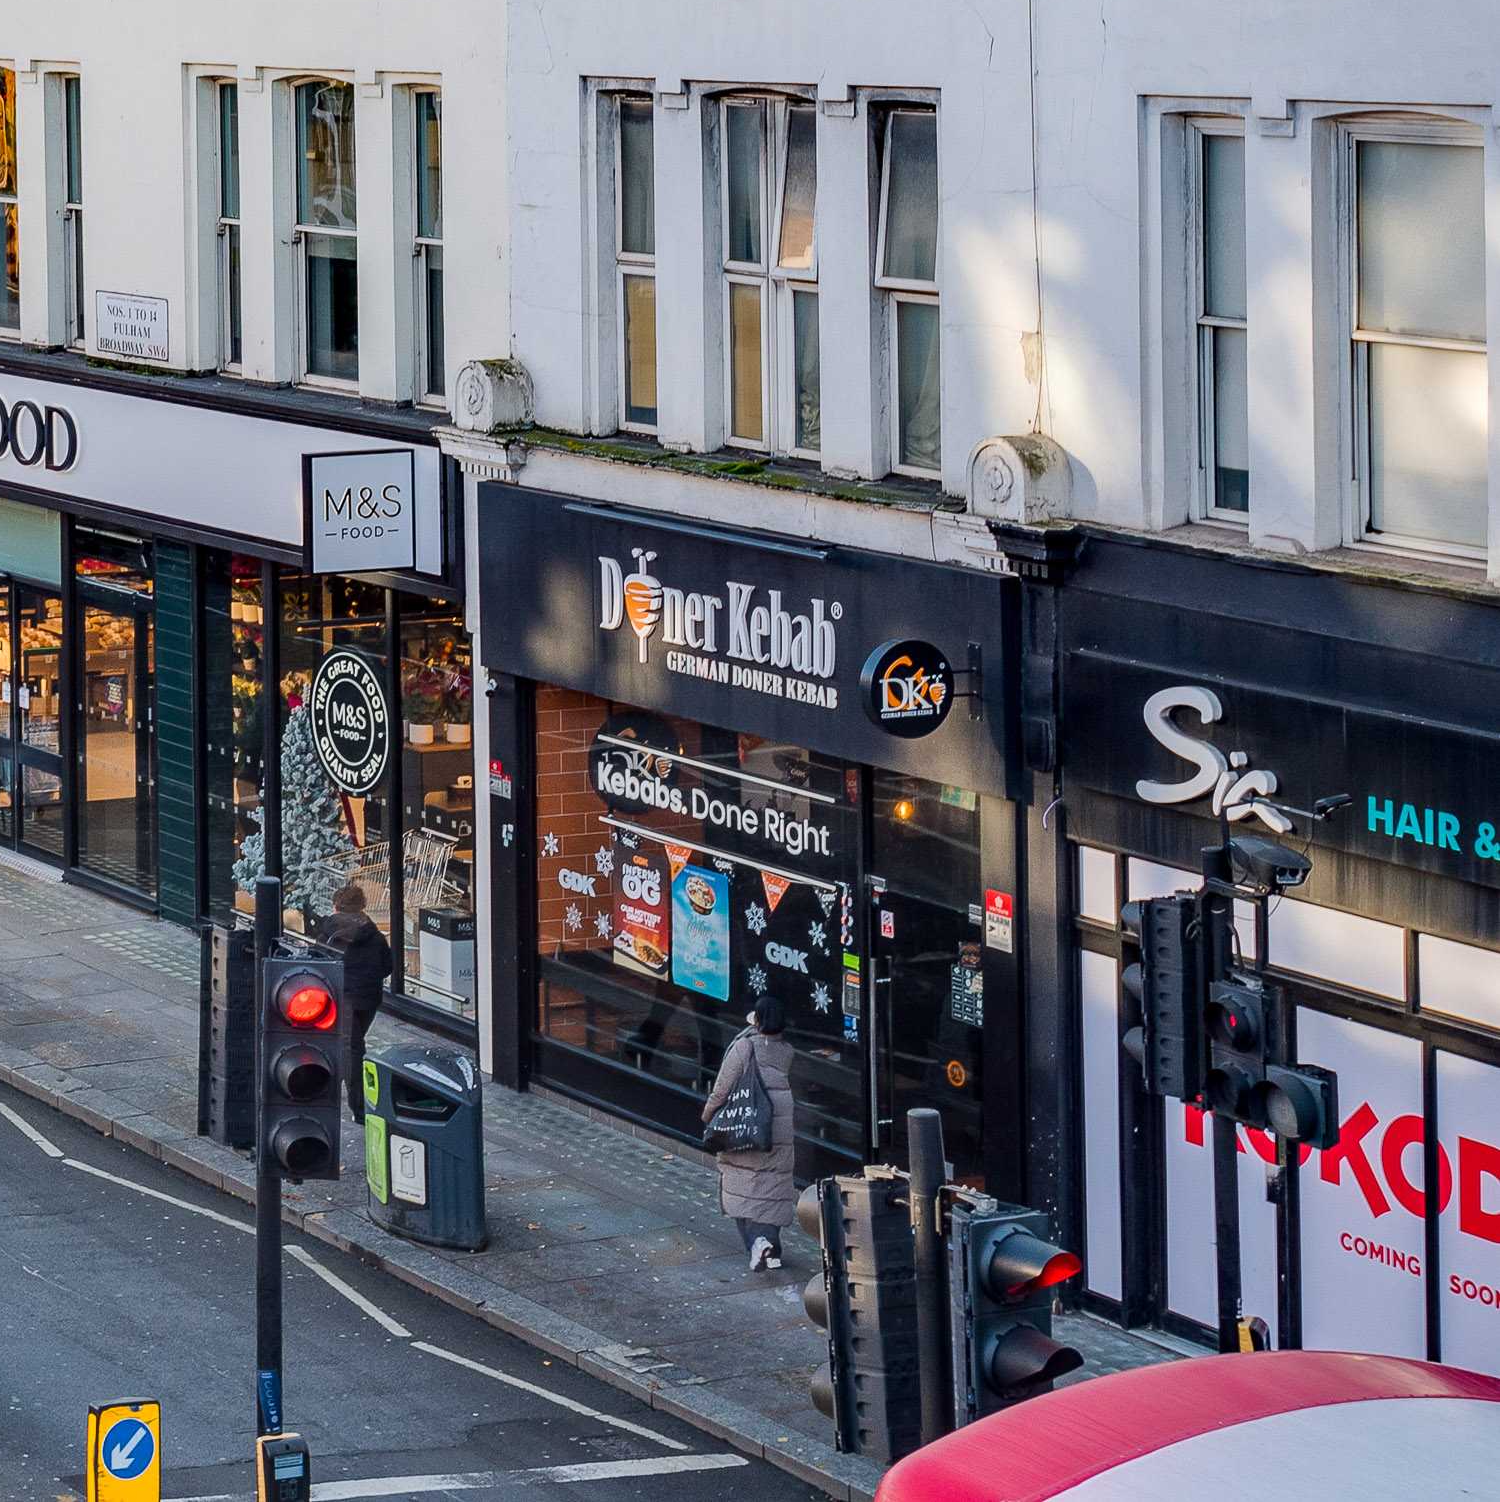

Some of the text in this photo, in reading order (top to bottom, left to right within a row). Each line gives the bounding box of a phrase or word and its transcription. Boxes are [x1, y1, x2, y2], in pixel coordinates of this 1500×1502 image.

[107, 305, 126, 318] NOS.
[136, 309, 147, 321] TO
[113, 322, 151, 339] FULHAM
[99, 338, 166, 358] BROADWAY SW6
[323, 483, 401, 522] M&S
[341, 526, 384, 540] FOOD
[316, 660, 384, 723] THE GREAT FOOD
[666, 650, 838, 709] GERMAN DONER KEBAB
[332, 701, 367, 730] M&S
[340, 729, 360, 741] FOOD
[321, 736, 382, 785] QUALITY SEAL
[598, 761, 831, 857] Kebabs. Done Right
[1367, 794, 1463, 855] HAIR
[559, 868, 596, 898] GDK
[622, 875, 661, 906] OG
[765, 941, 809, 974] GDK
[1340, 1231, 1421, 1276] COMING
